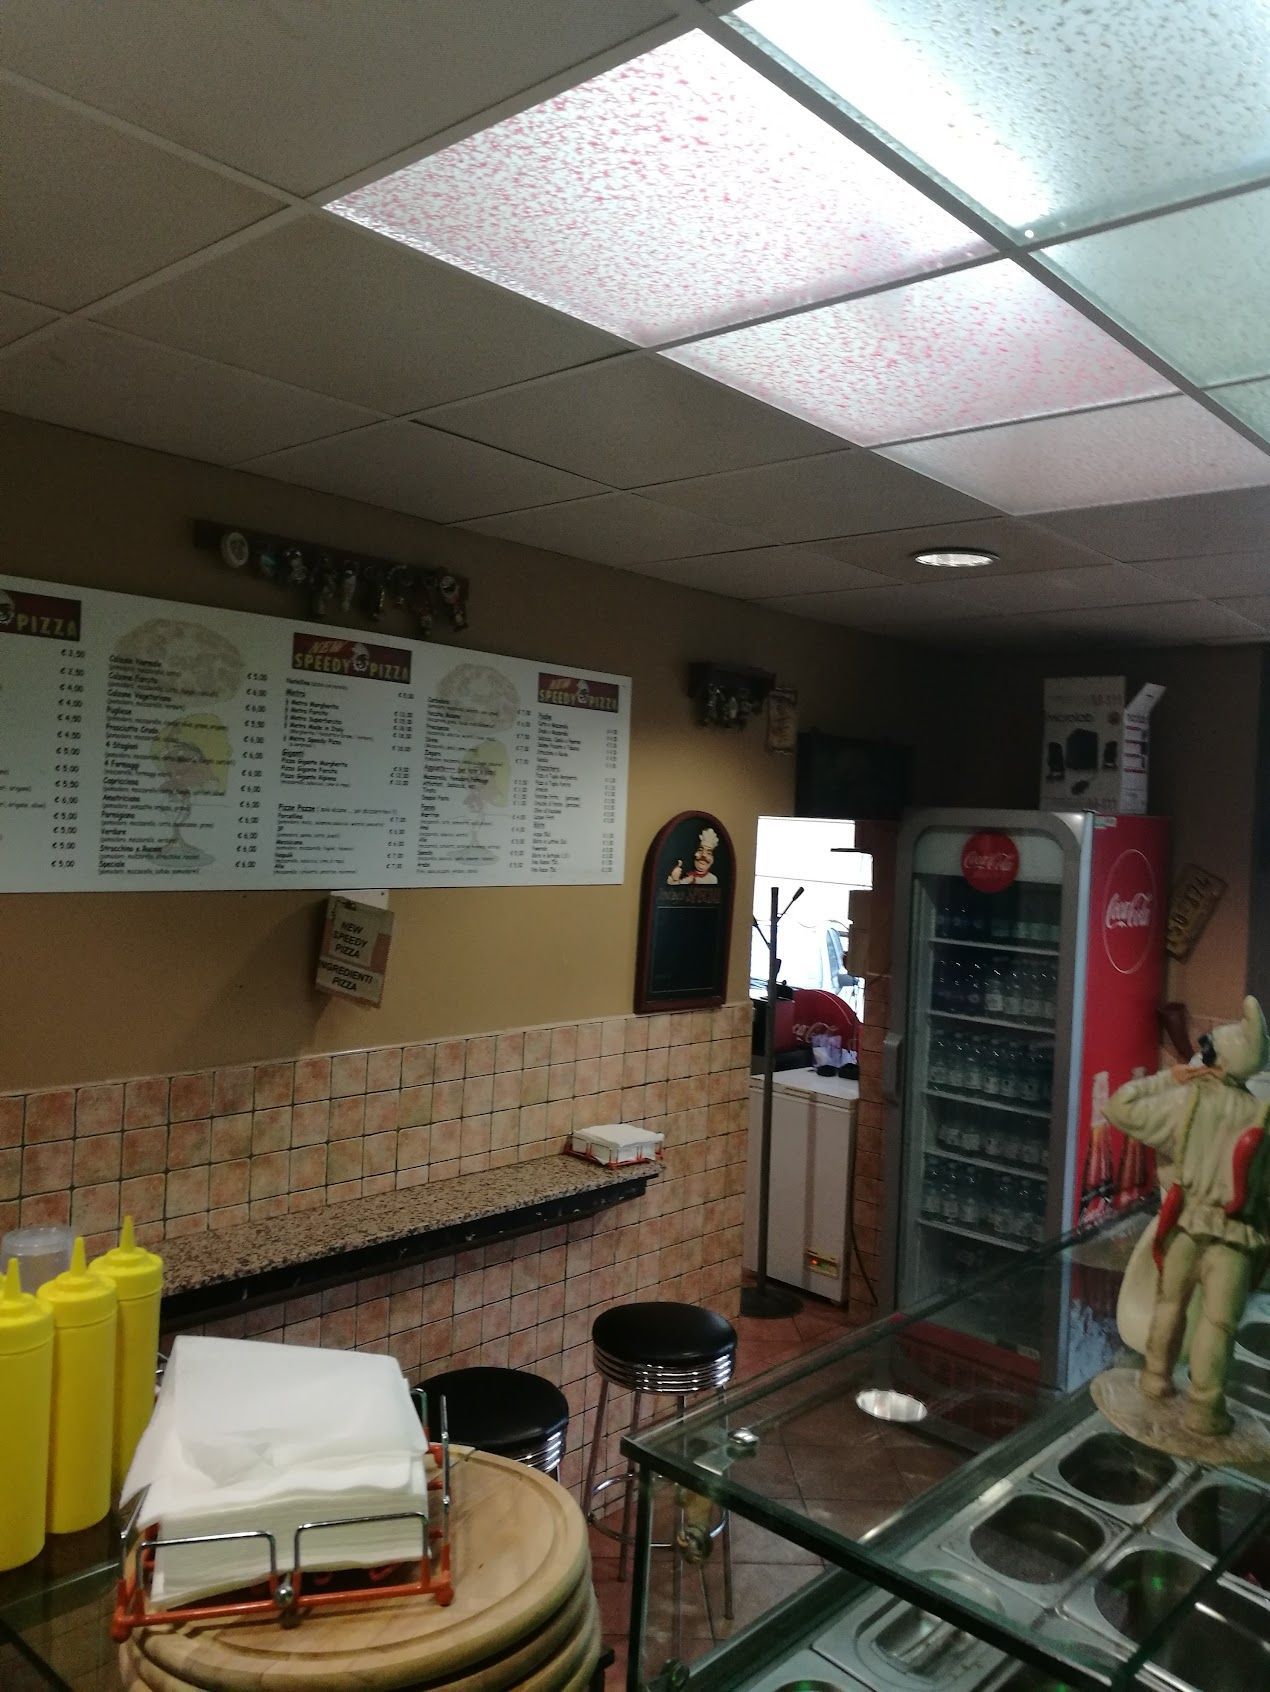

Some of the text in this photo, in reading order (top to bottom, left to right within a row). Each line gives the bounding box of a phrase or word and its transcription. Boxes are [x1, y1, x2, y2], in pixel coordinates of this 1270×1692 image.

[16, 612, 77, 637] PIZZA
[294, 653, 409, 681] SPEEDY PIZZA
[1105, 892, 1153, 929] Coca-Cola
[341, 922, 364, 935] NEW
[333, 930, 369, 948] SPEEDY
[335, 943, 361, 959] PIZZA
[332, 976, 358, 992] PIZZA
